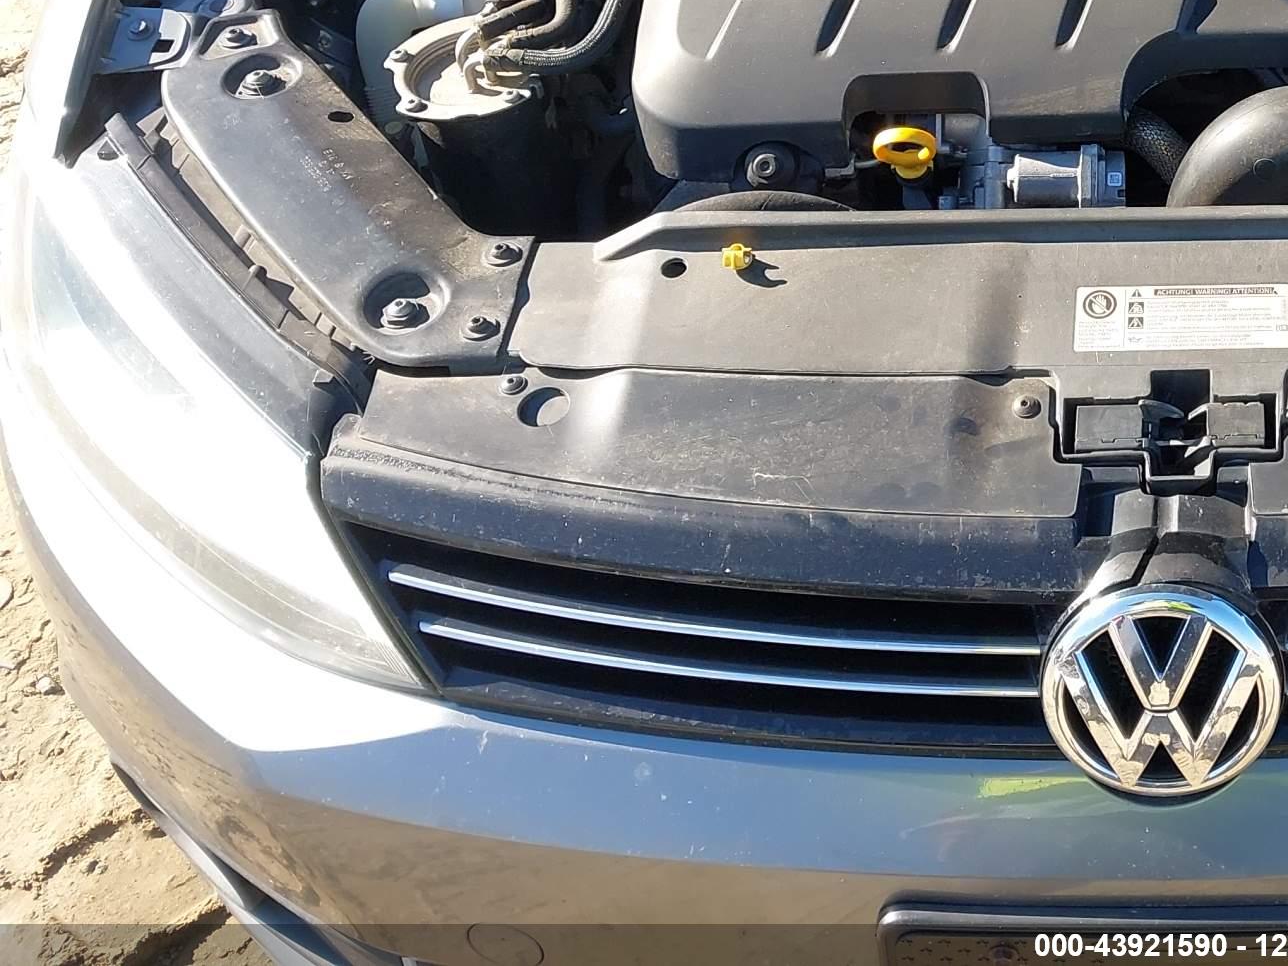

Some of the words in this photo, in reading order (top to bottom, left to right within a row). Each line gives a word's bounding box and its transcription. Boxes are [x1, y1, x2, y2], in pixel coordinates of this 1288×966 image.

[1156, 288, 1194, 296] ACHTUNG!
[1195, 287, 1231, 295] WARNING!
[1231, 286, 1275, 295] ATTENTION!
[1049, 596, 1273, 791] VW
